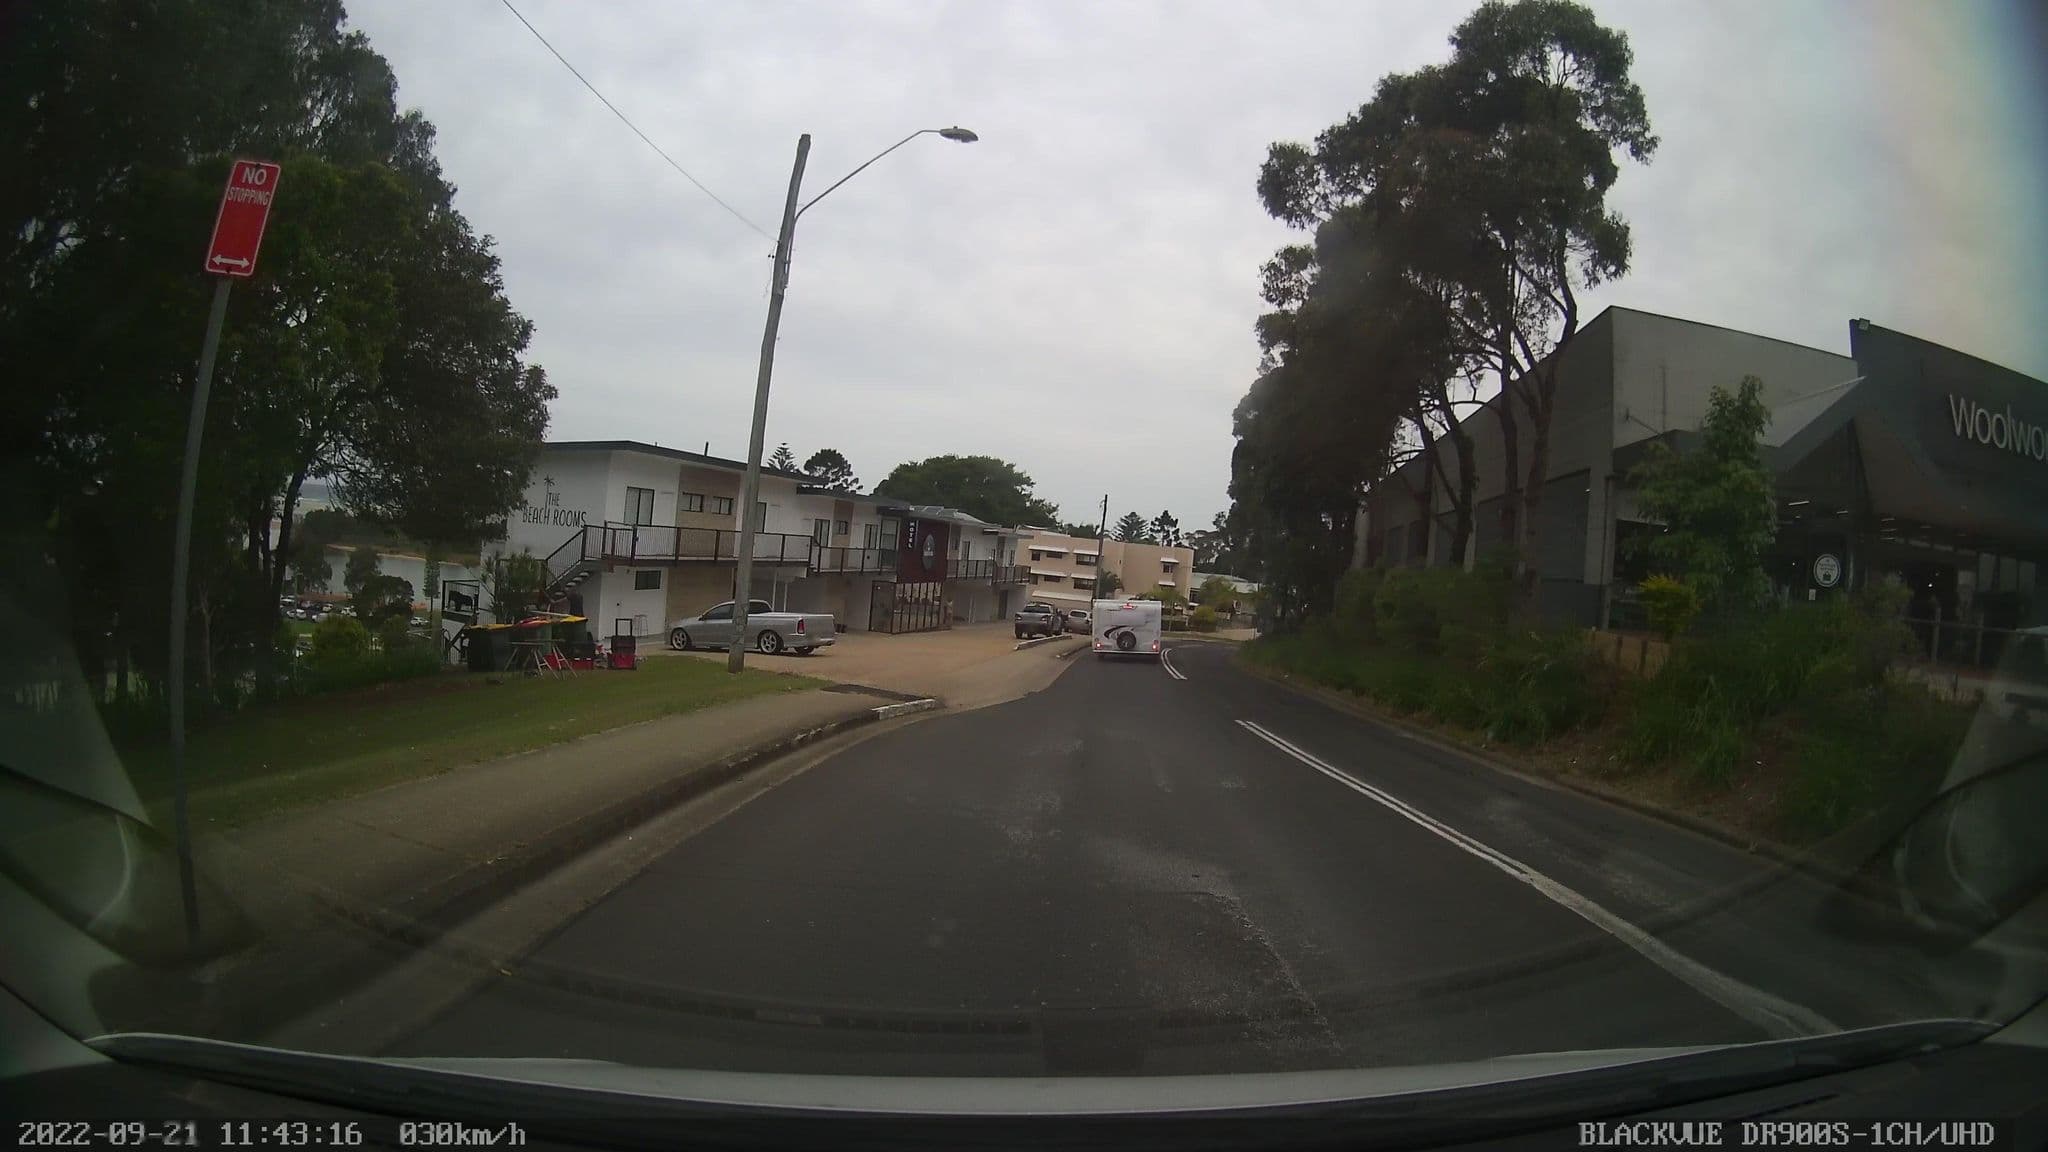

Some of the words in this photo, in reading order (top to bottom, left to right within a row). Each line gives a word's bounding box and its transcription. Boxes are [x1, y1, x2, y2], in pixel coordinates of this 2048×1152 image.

[241, 167, 267, 186] NO
[227, 186, 271, 206] STOPPING
[548, 492, 560, 507] THE
[522, 505, 550, 526] BEACH
[553, 509, 587, 528] ROOMS
